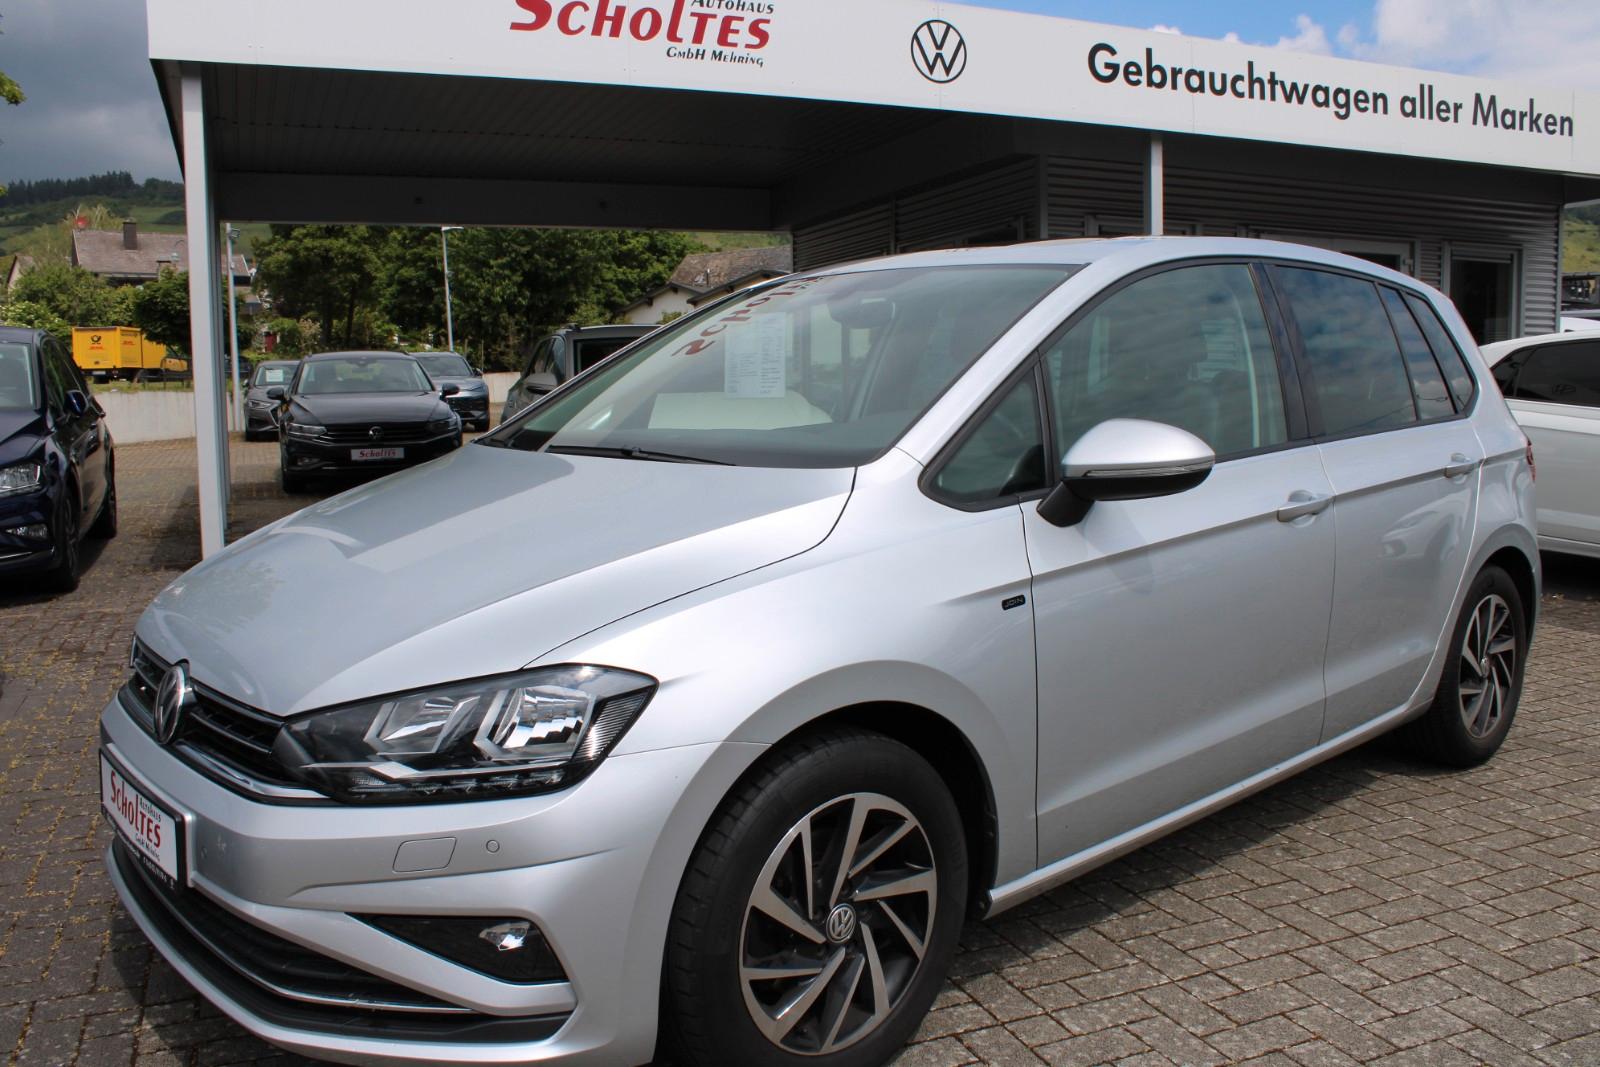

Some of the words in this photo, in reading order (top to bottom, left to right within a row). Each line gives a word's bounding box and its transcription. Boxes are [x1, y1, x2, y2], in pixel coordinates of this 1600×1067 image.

[1087, 42, 1389, 120] Gebrauchtwagen
[1400, 83, 1463, 123] aller
[1472, 93, 1575, 137] Marken
